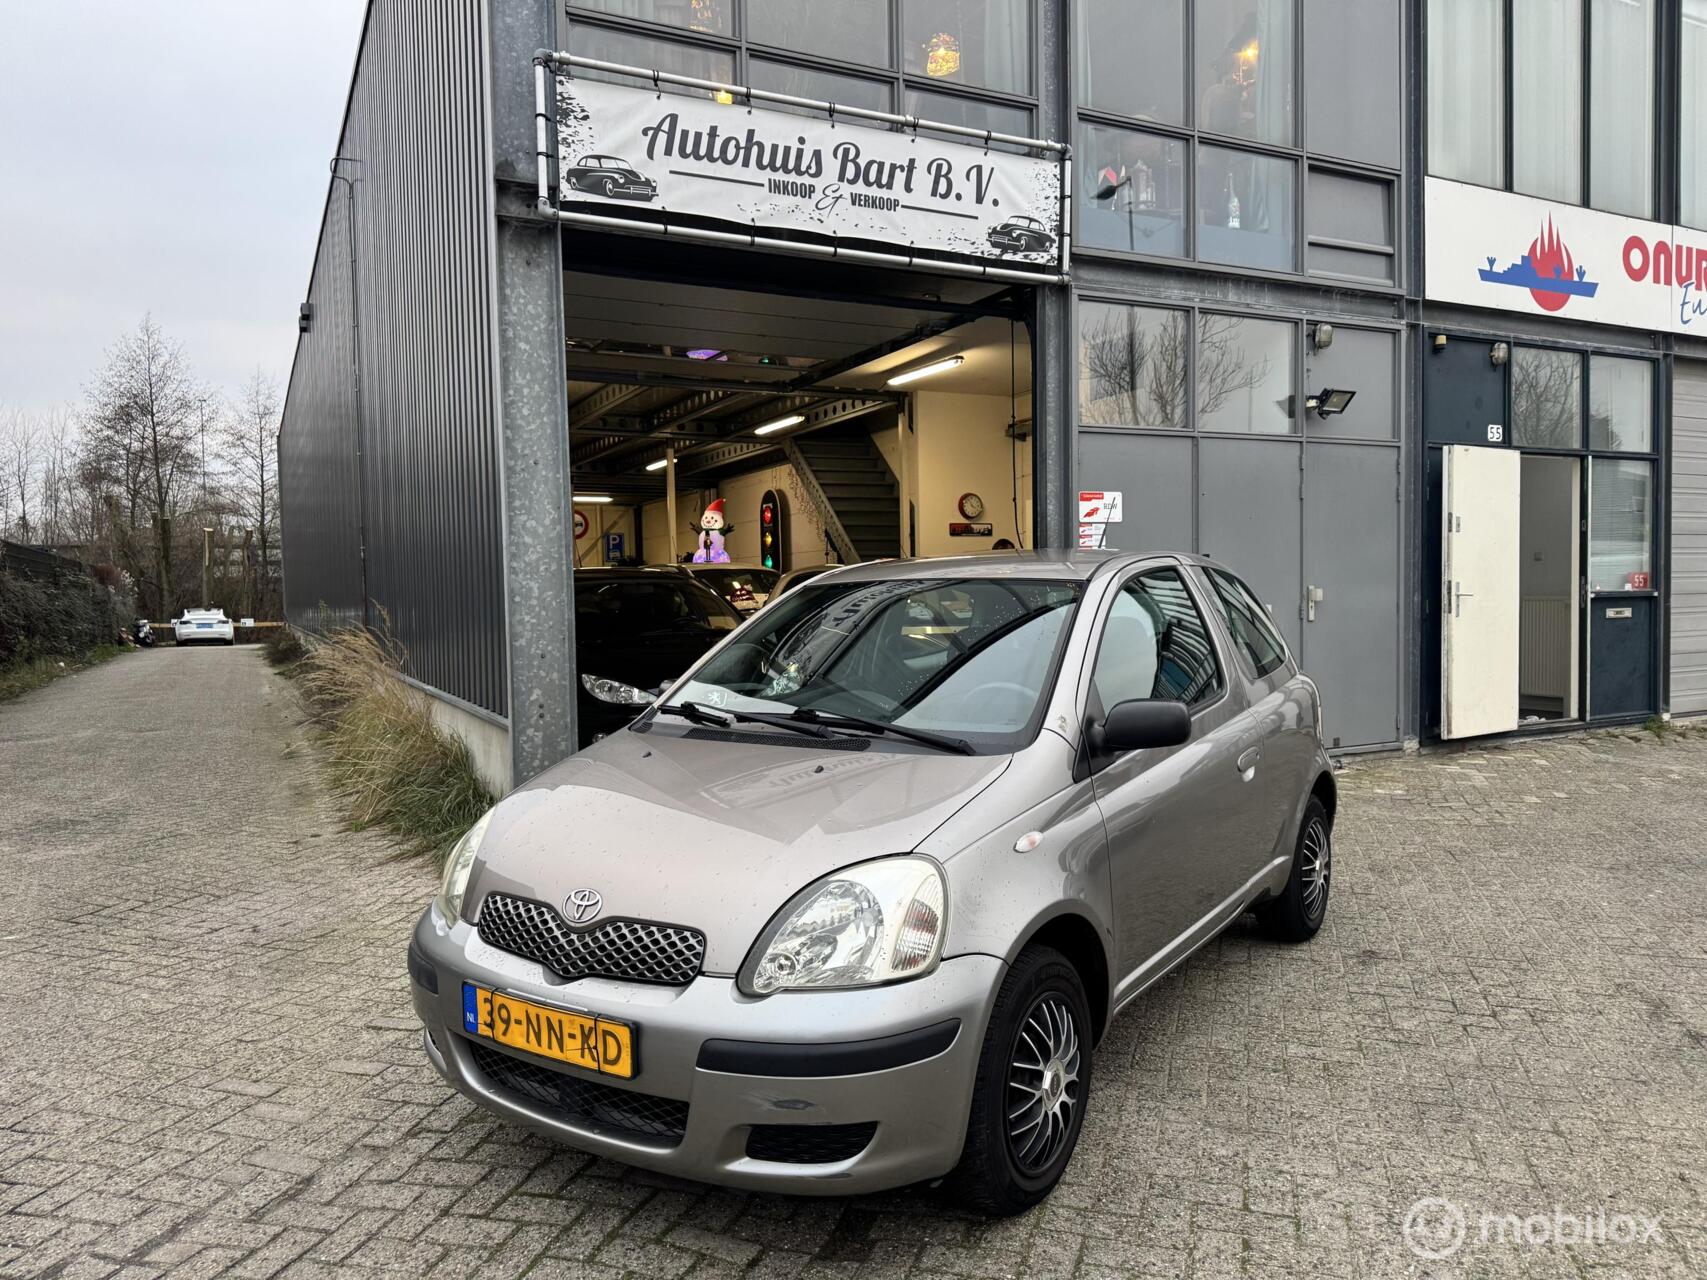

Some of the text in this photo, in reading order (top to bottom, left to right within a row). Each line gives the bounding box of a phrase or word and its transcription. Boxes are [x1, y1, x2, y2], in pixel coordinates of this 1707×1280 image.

[642, 112, 1001, 207] Autohuis Bart B.V.
[767, 177, 900, 218] INKOOP & VERKOOP
[1489, 426, 1501, 440] 55
[609, 535, 620, 549] P
[1634, 574, 1644, 587] 55
[466, 1012, 475, 1024] NL
[483, 997, 622, 1066] 39-NN-KD
